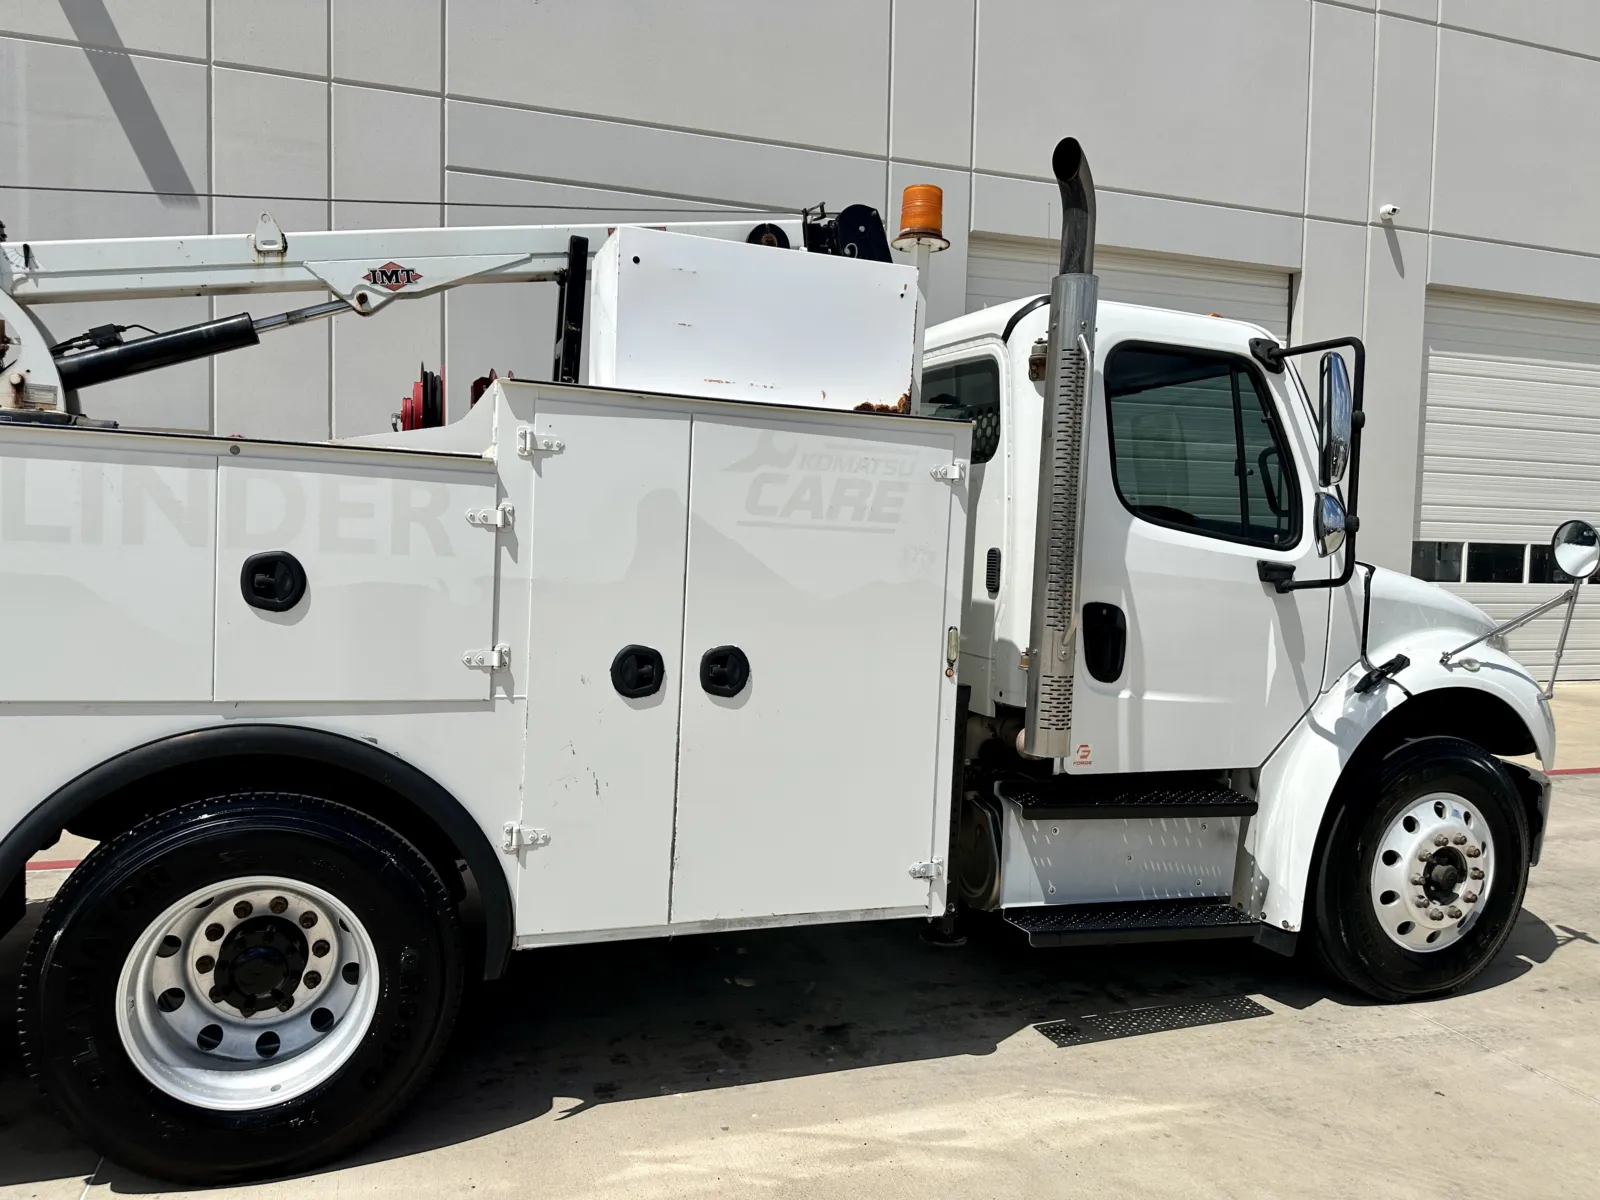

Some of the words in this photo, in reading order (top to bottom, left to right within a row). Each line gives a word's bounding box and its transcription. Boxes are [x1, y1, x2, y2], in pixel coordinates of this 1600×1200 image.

[369, 269, 415, 285] IMT
[798, 452, 916, 477] KOMATSU
[2, 457, 456, 557] LINDER
[745, 472, 910, 523] CARE
